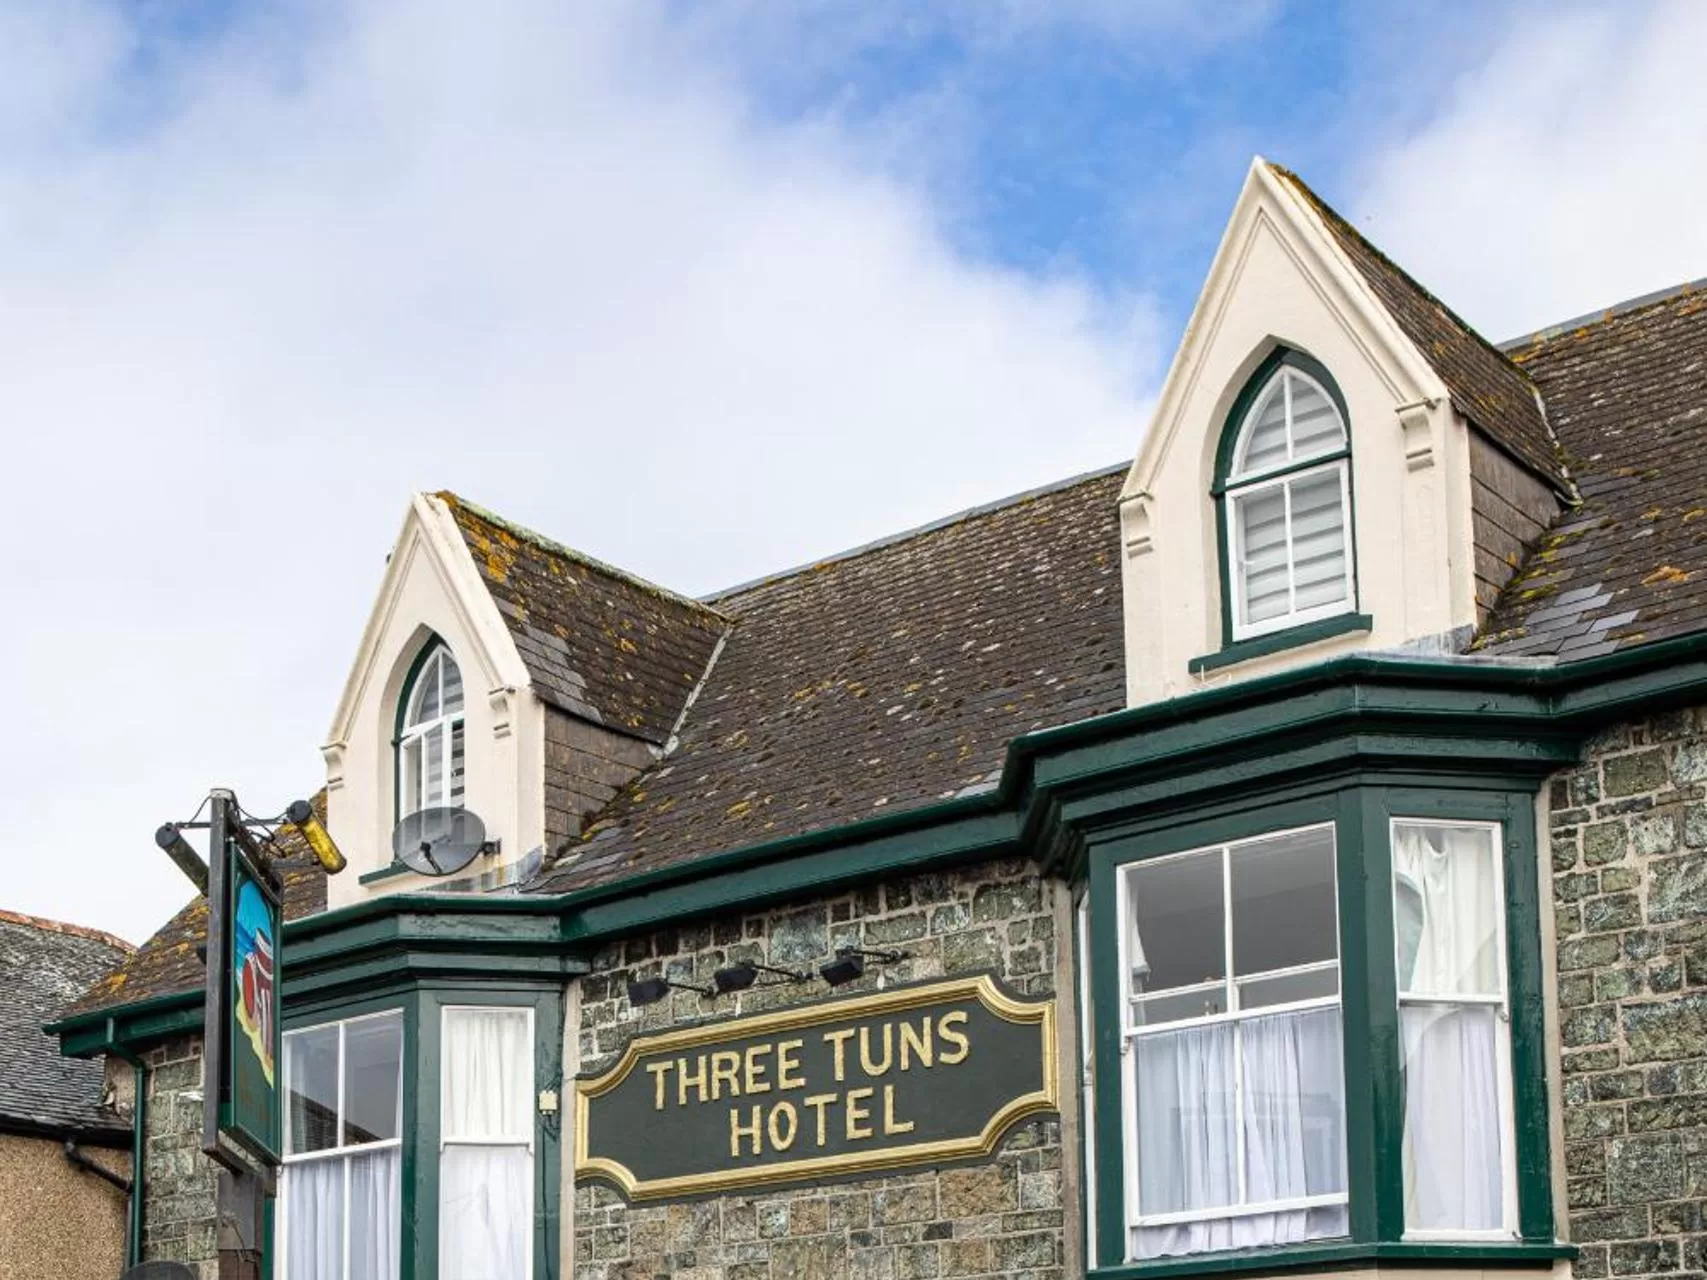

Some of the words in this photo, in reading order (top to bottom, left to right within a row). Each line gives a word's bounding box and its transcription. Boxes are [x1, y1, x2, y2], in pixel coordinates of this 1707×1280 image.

[645, 1038, 807, 1110] THREE
[823, 1010, 970, 1082] TUNS
[729, 1085, 914, 1158] HOTEL
